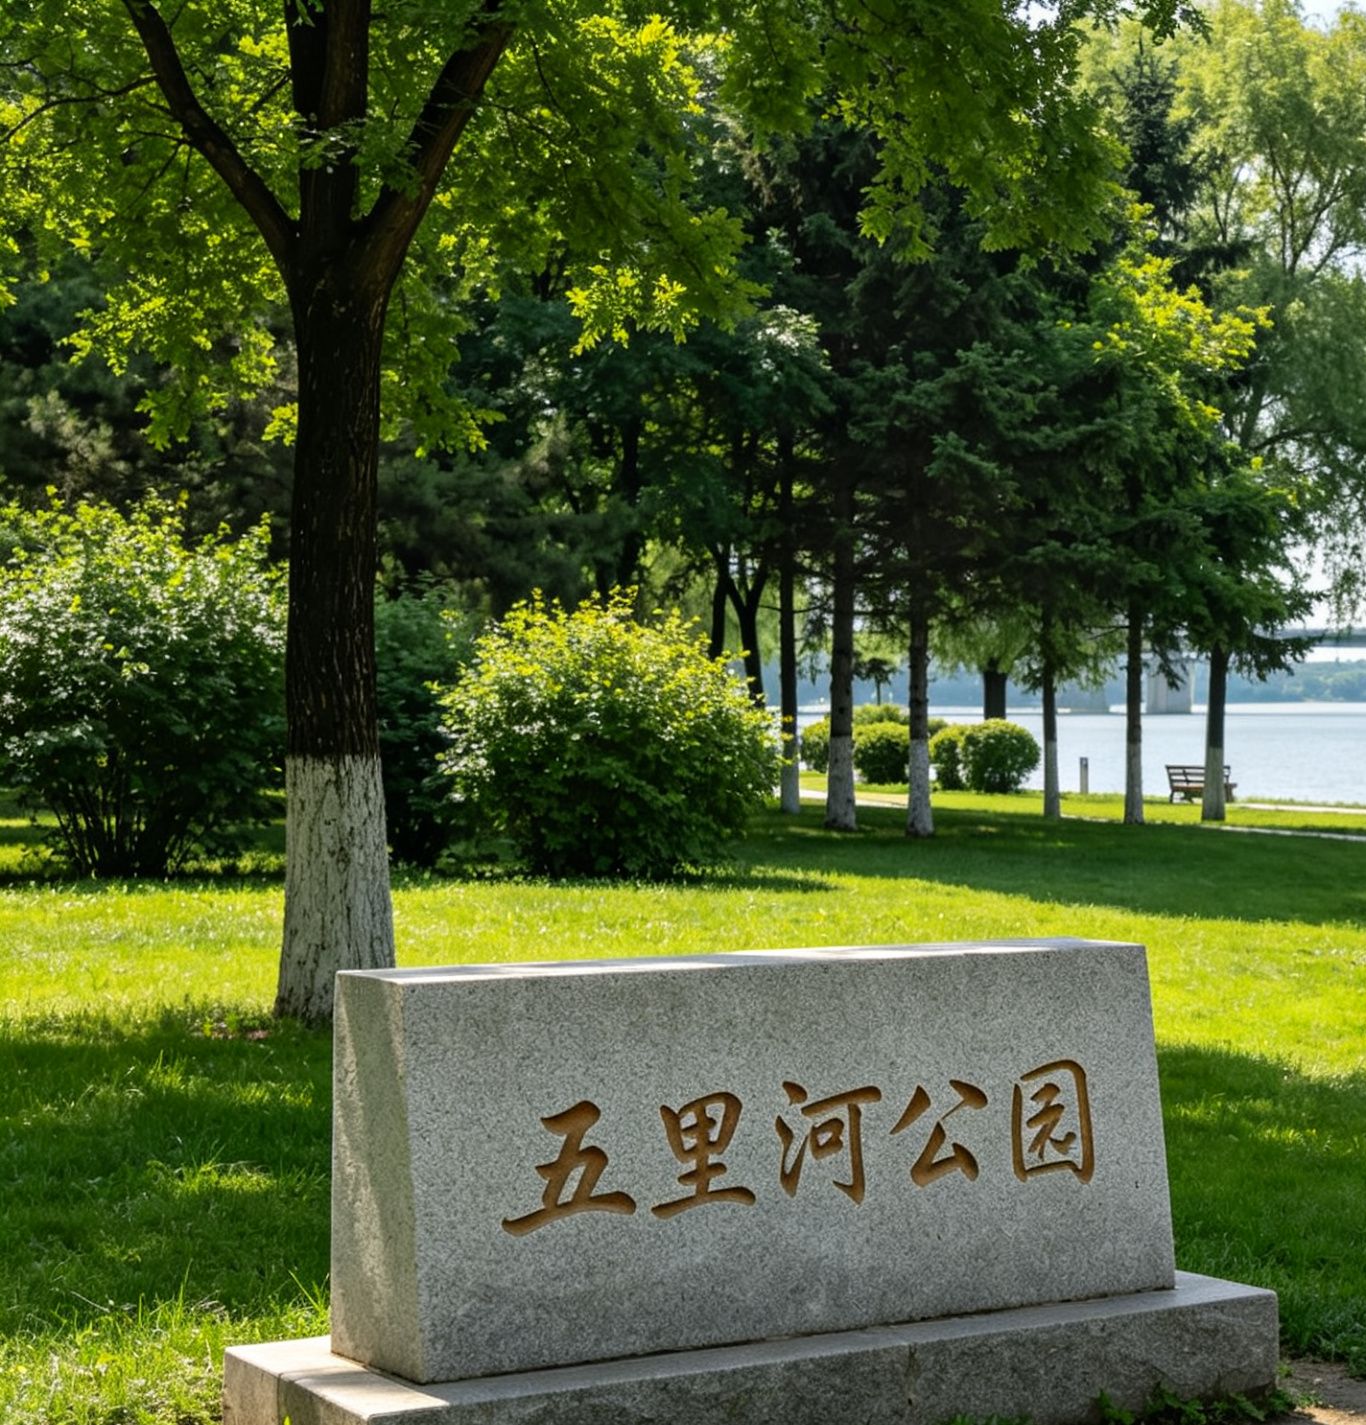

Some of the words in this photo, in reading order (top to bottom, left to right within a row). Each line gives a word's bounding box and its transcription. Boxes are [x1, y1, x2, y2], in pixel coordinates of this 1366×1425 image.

[502, 1058, 1096, 1237] 五里河公园
